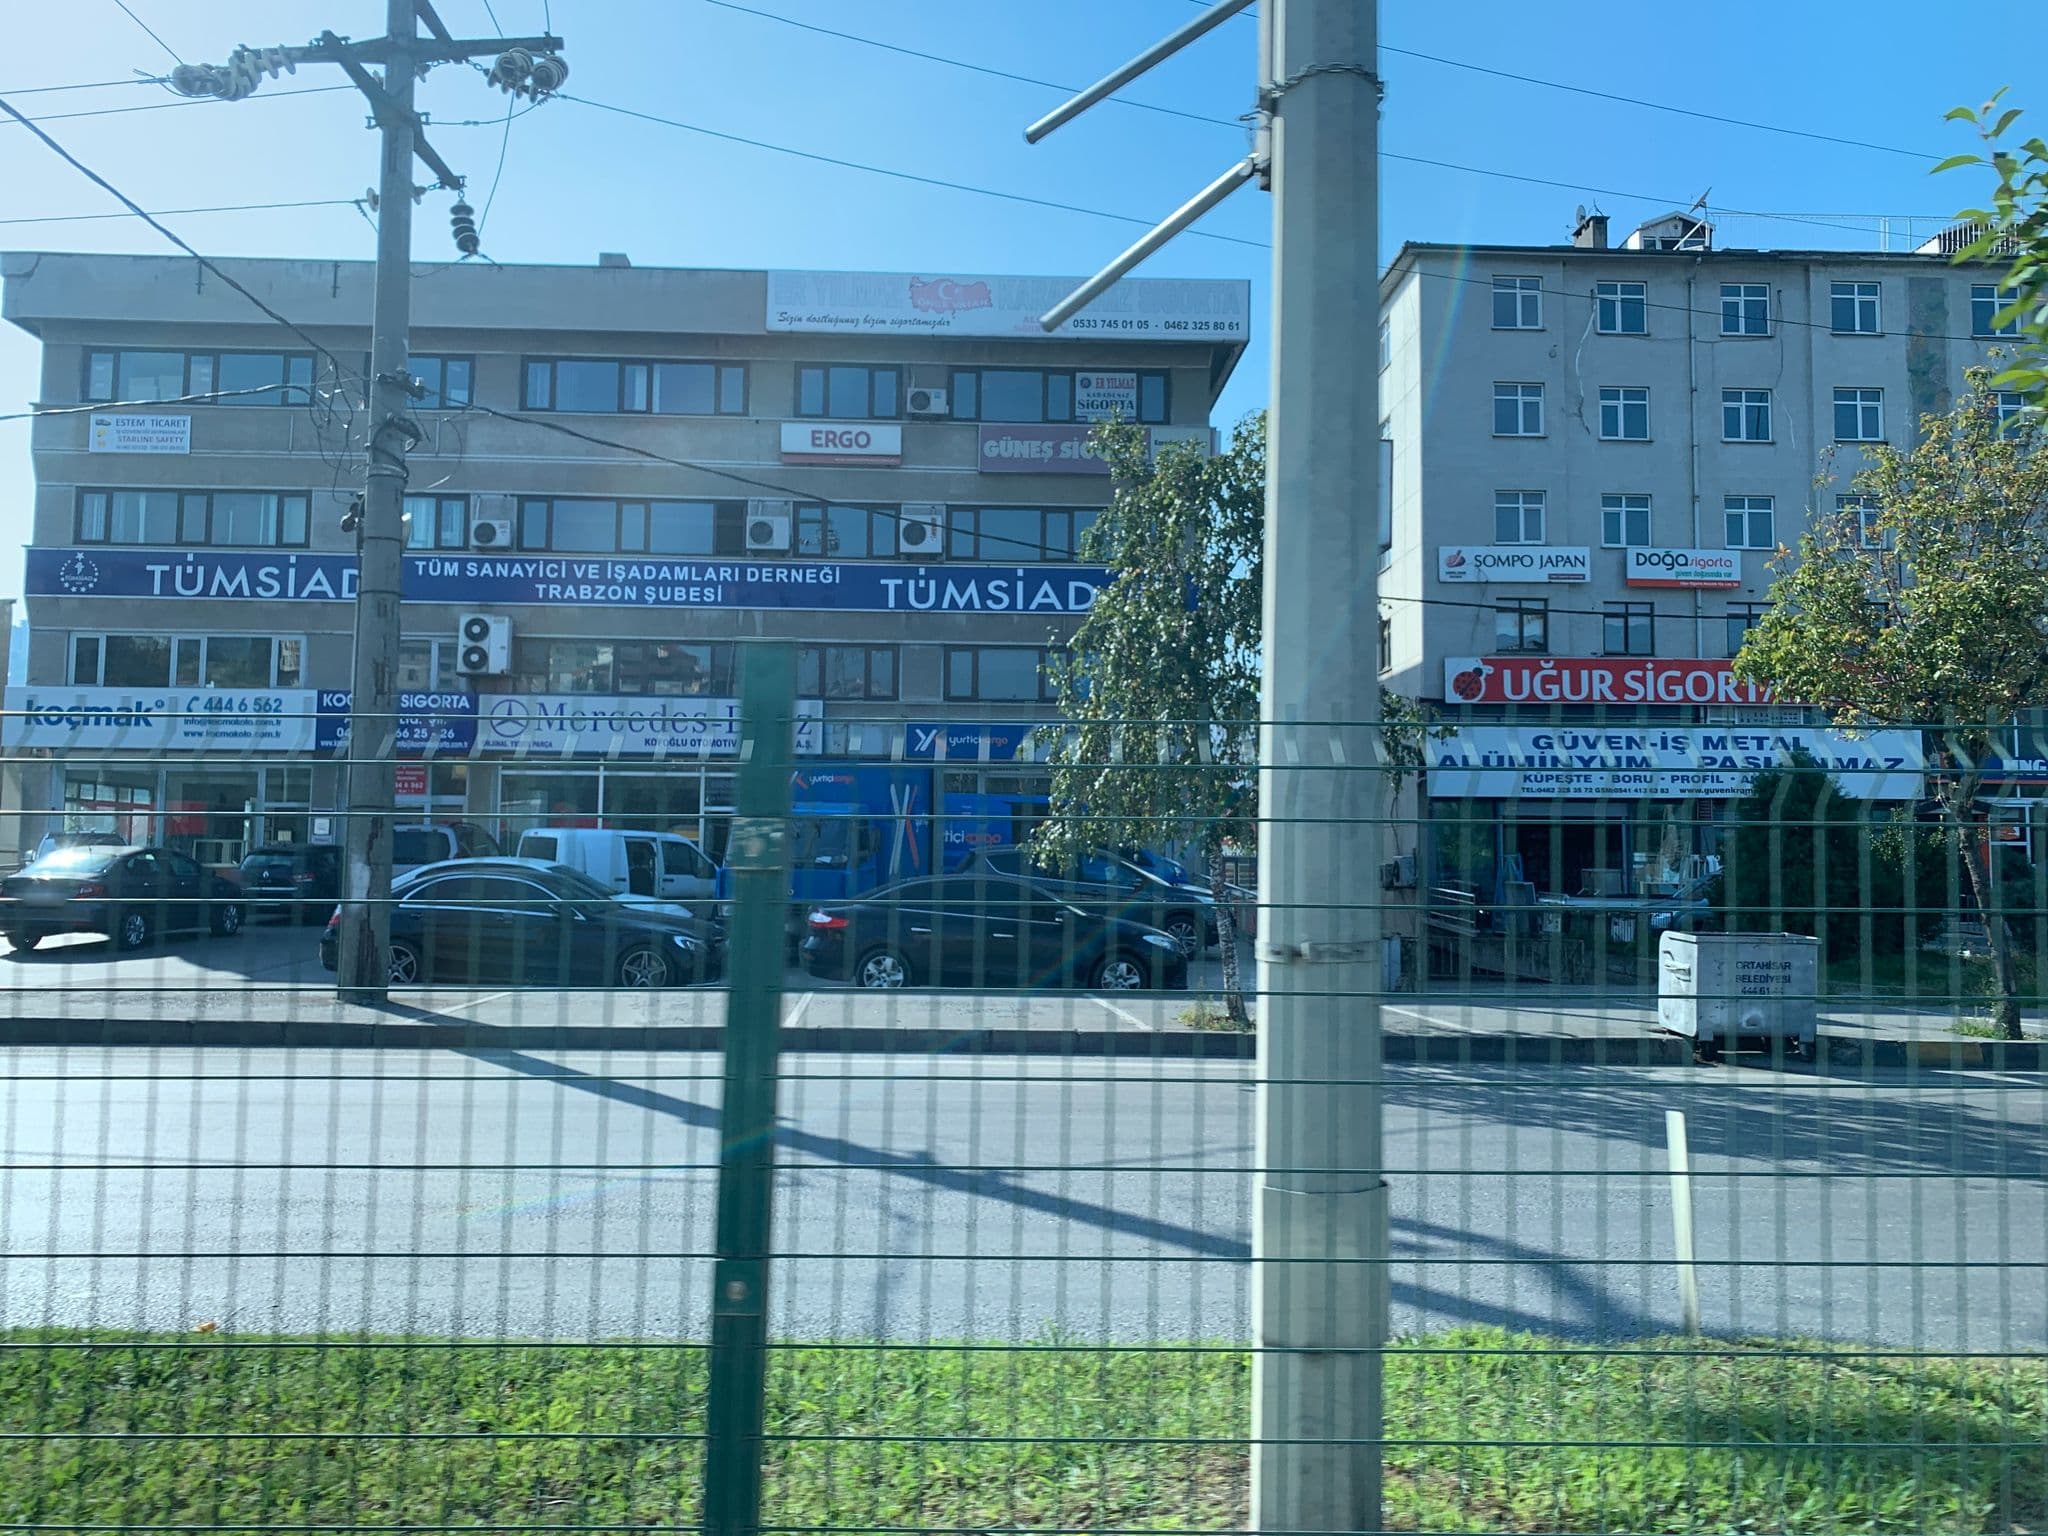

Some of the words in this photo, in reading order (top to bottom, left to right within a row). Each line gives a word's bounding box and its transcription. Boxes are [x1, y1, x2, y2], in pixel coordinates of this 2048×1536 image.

[862, 314, 887, 327] bizim
[1073, 319, 1097, 329] 0533
[1101, 319, 1119, 329] 745
[1121, 320, 1134, 329] 01
[1137, 320, 1149, 330] 05
[1164, 320, 1189, 330] 0462
[1191, 321, 1210, 330] 325
[1213, 322, 1225, 331] 80
[1228, 322, 1240, 331] 61
[116, 418, 146, 427] ESTEM
[810, 429, 871, 449] ERGO
[984, 436, 1054, 463] GÜNEŞ
[415, 559, 459, 576] TÜM
[466, 560, 566, 579] SANAYİCİ
[573, 564, 600, 579] VE
[607, 561, 739, 582] İŞADAMLARI
[746, 566, 840, 584] DERNEĞİ
[1474, 554, 1534, 568] SOMPO
[1538, 555, 1586, 569] JAPAN
[535, 583, 636, 600] TRABZON
[644, 584, 722, 604] ŞUBESİ
[880, 567, 1096, 610] TÜMSİAD
[1503, 660, 1617, 701] UĞUR
[24, 699, 153, 730] koçmak
[203, 696, 233, 713] 444
[238, 697, 248, 713] 6
[253, 697, 282, 713] 562
[536, 702, 813, 737] Mercedes-Bz
[414, 728, 428, 739] 25
[1532, 731, 1690, 755] GÜVEN-İŞ
[1702, 735, 1810, 752] METAL
[1697, 756, 1905, 770] PASLNMAZ
[1523, 772, 1593, 784] KÜPEŞTE
[1611, 774, 1653, 784] BORU
[1670, 772, 1724, 784] PROFİL
